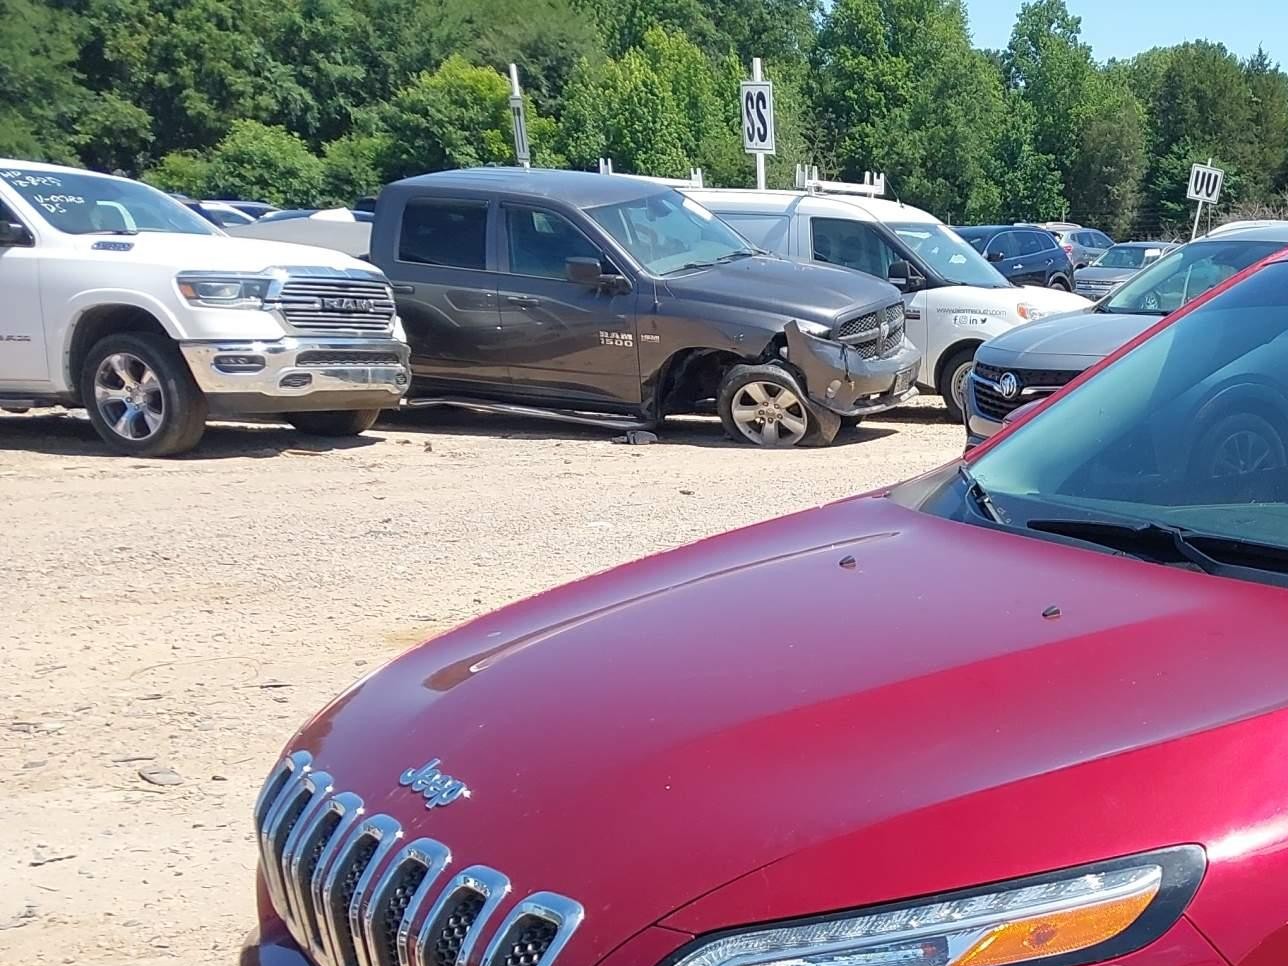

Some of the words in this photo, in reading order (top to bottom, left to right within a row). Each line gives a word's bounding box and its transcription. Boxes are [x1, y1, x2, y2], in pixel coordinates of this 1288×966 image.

[745, 91, 768, 142] SS
[600, 331, 632, 340] RAM
[600, 338, 633, 347] 1500
[400, 758, 466, 809] Jeep
